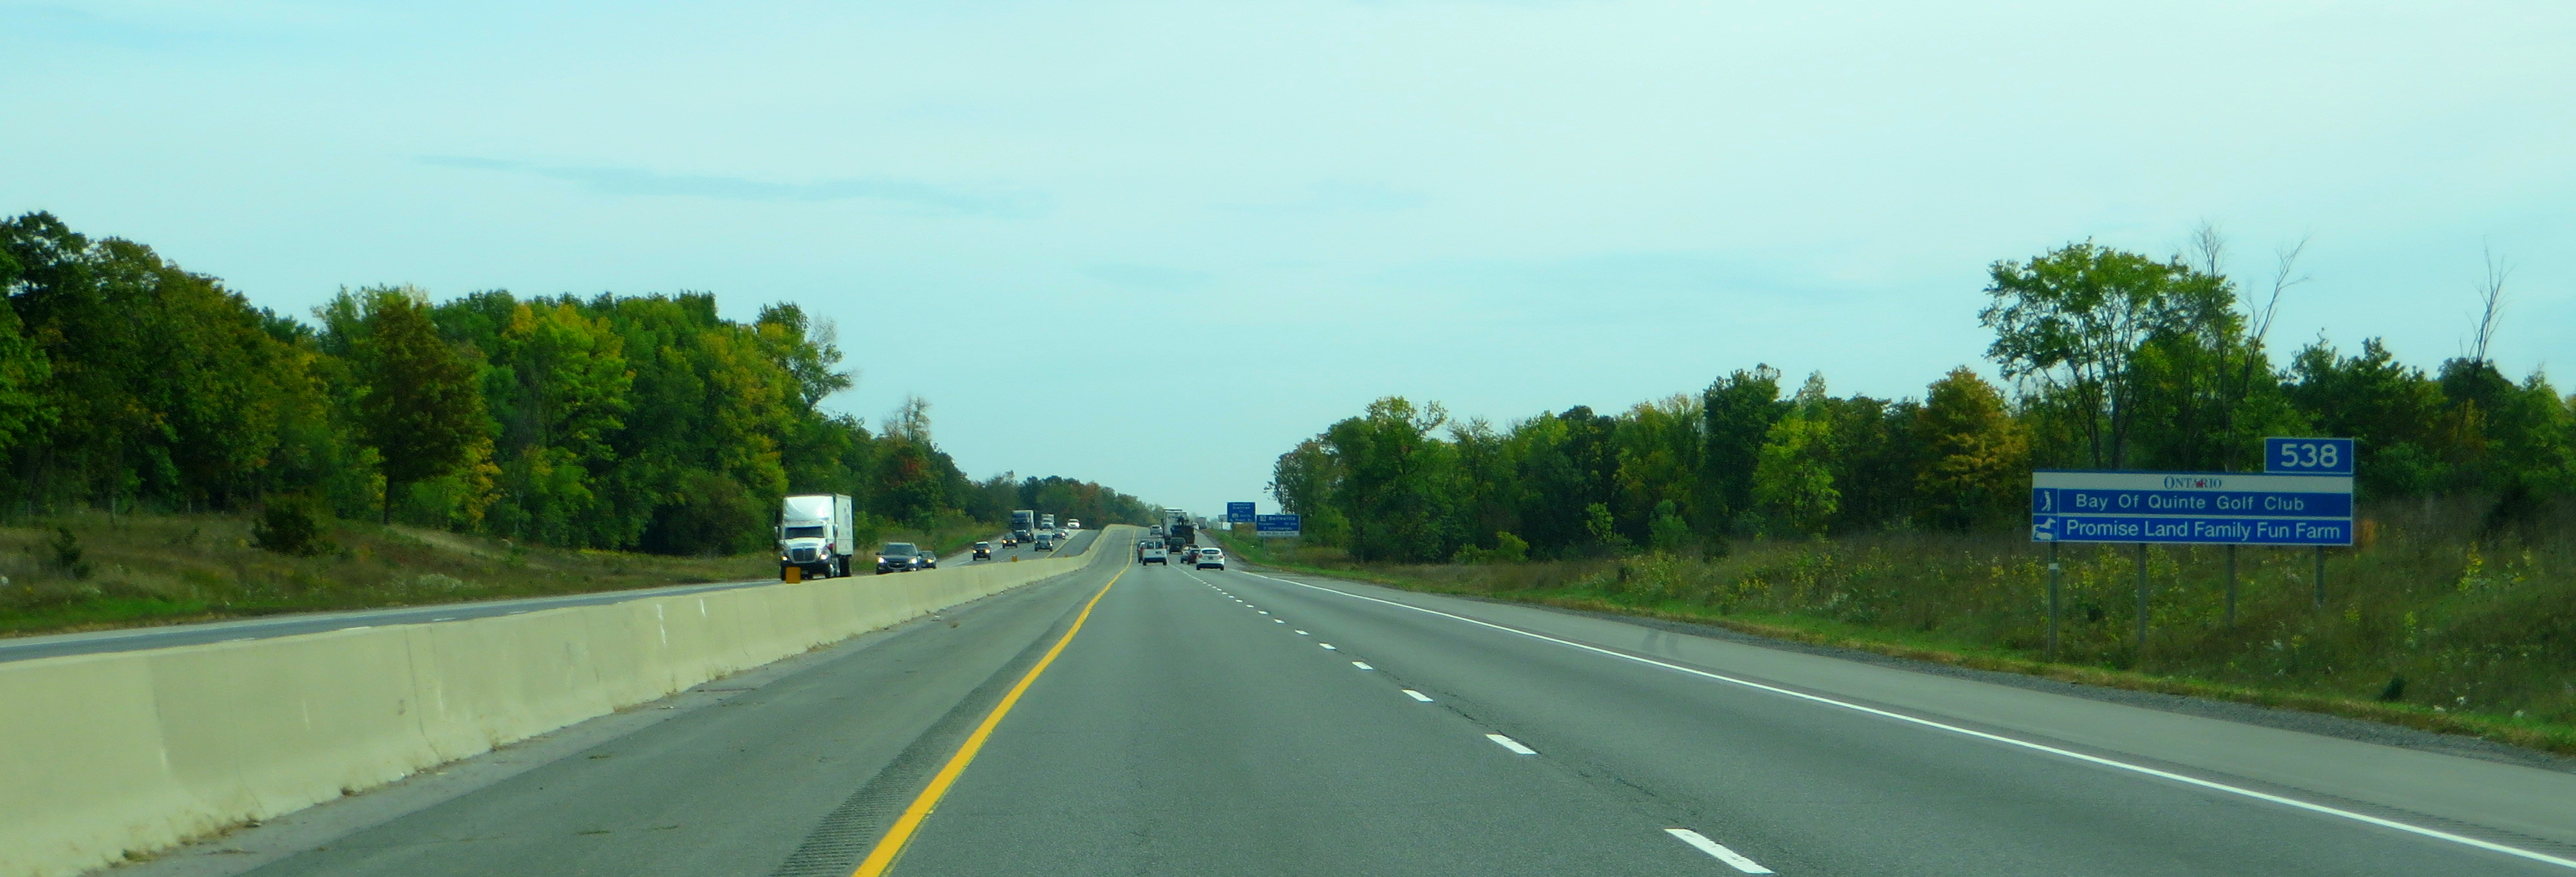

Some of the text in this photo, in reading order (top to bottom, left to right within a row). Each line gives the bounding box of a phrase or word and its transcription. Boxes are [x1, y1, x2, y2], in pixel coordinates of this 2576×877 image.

[2281, 443, 2338, 467] 538
[2076, 494, 2304, 511] Bay Of Quinte Golf Club
[2067, 519, 2340, 542] Promise Land Family Fun Farm
